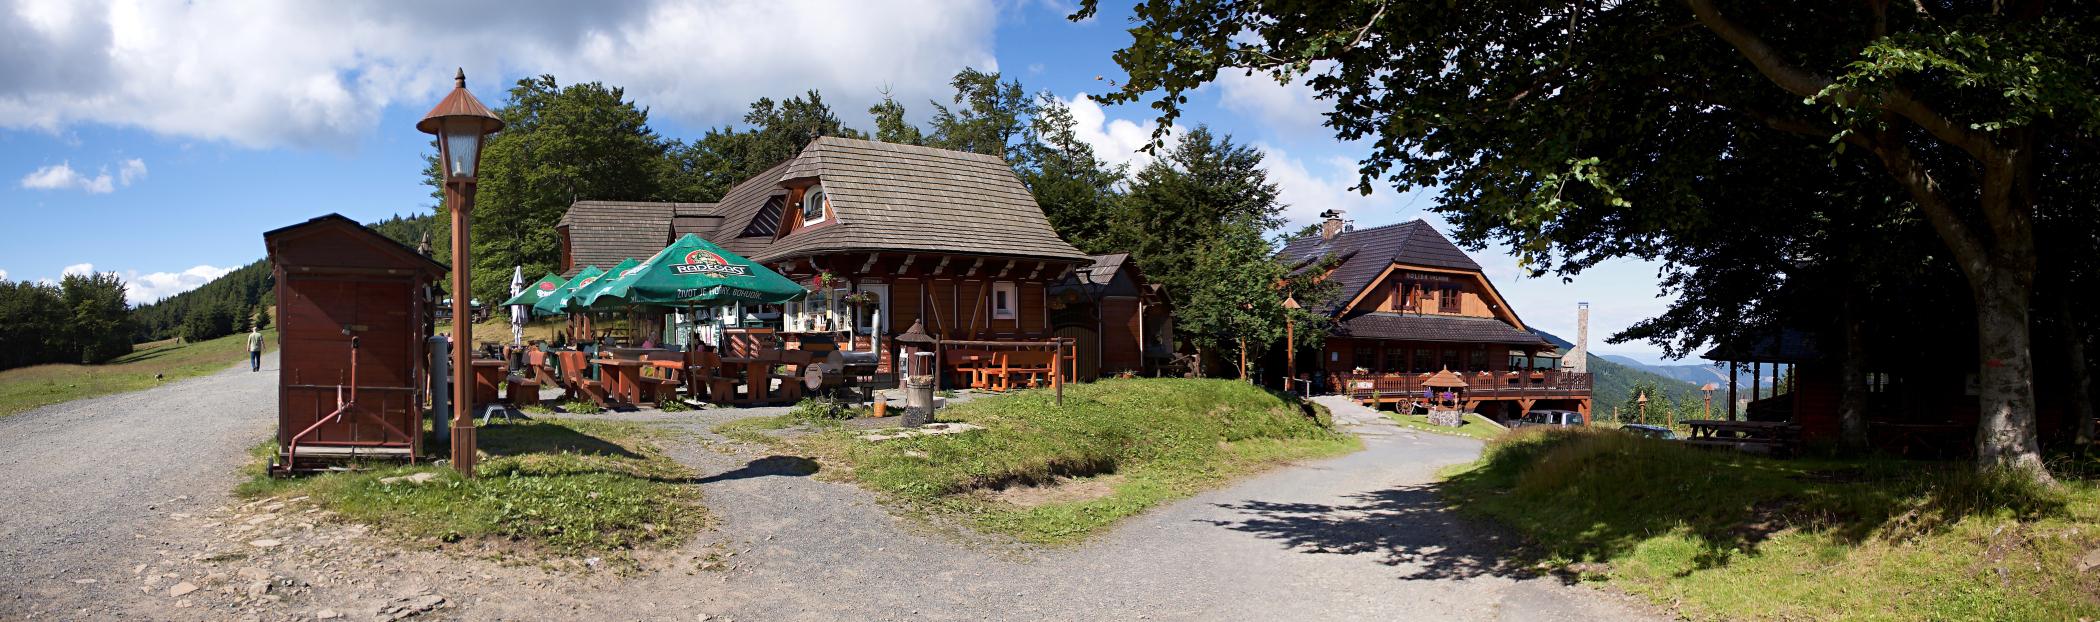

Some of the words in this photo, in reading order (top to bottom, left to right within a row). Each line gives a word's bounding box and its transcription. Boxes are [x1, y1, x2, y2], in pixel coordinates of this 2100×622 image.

[676, 263, 745, 274] RADEGAST
[677, 288, 697, 298] ŽIVOT
[699, 287, 706, 297] JE
